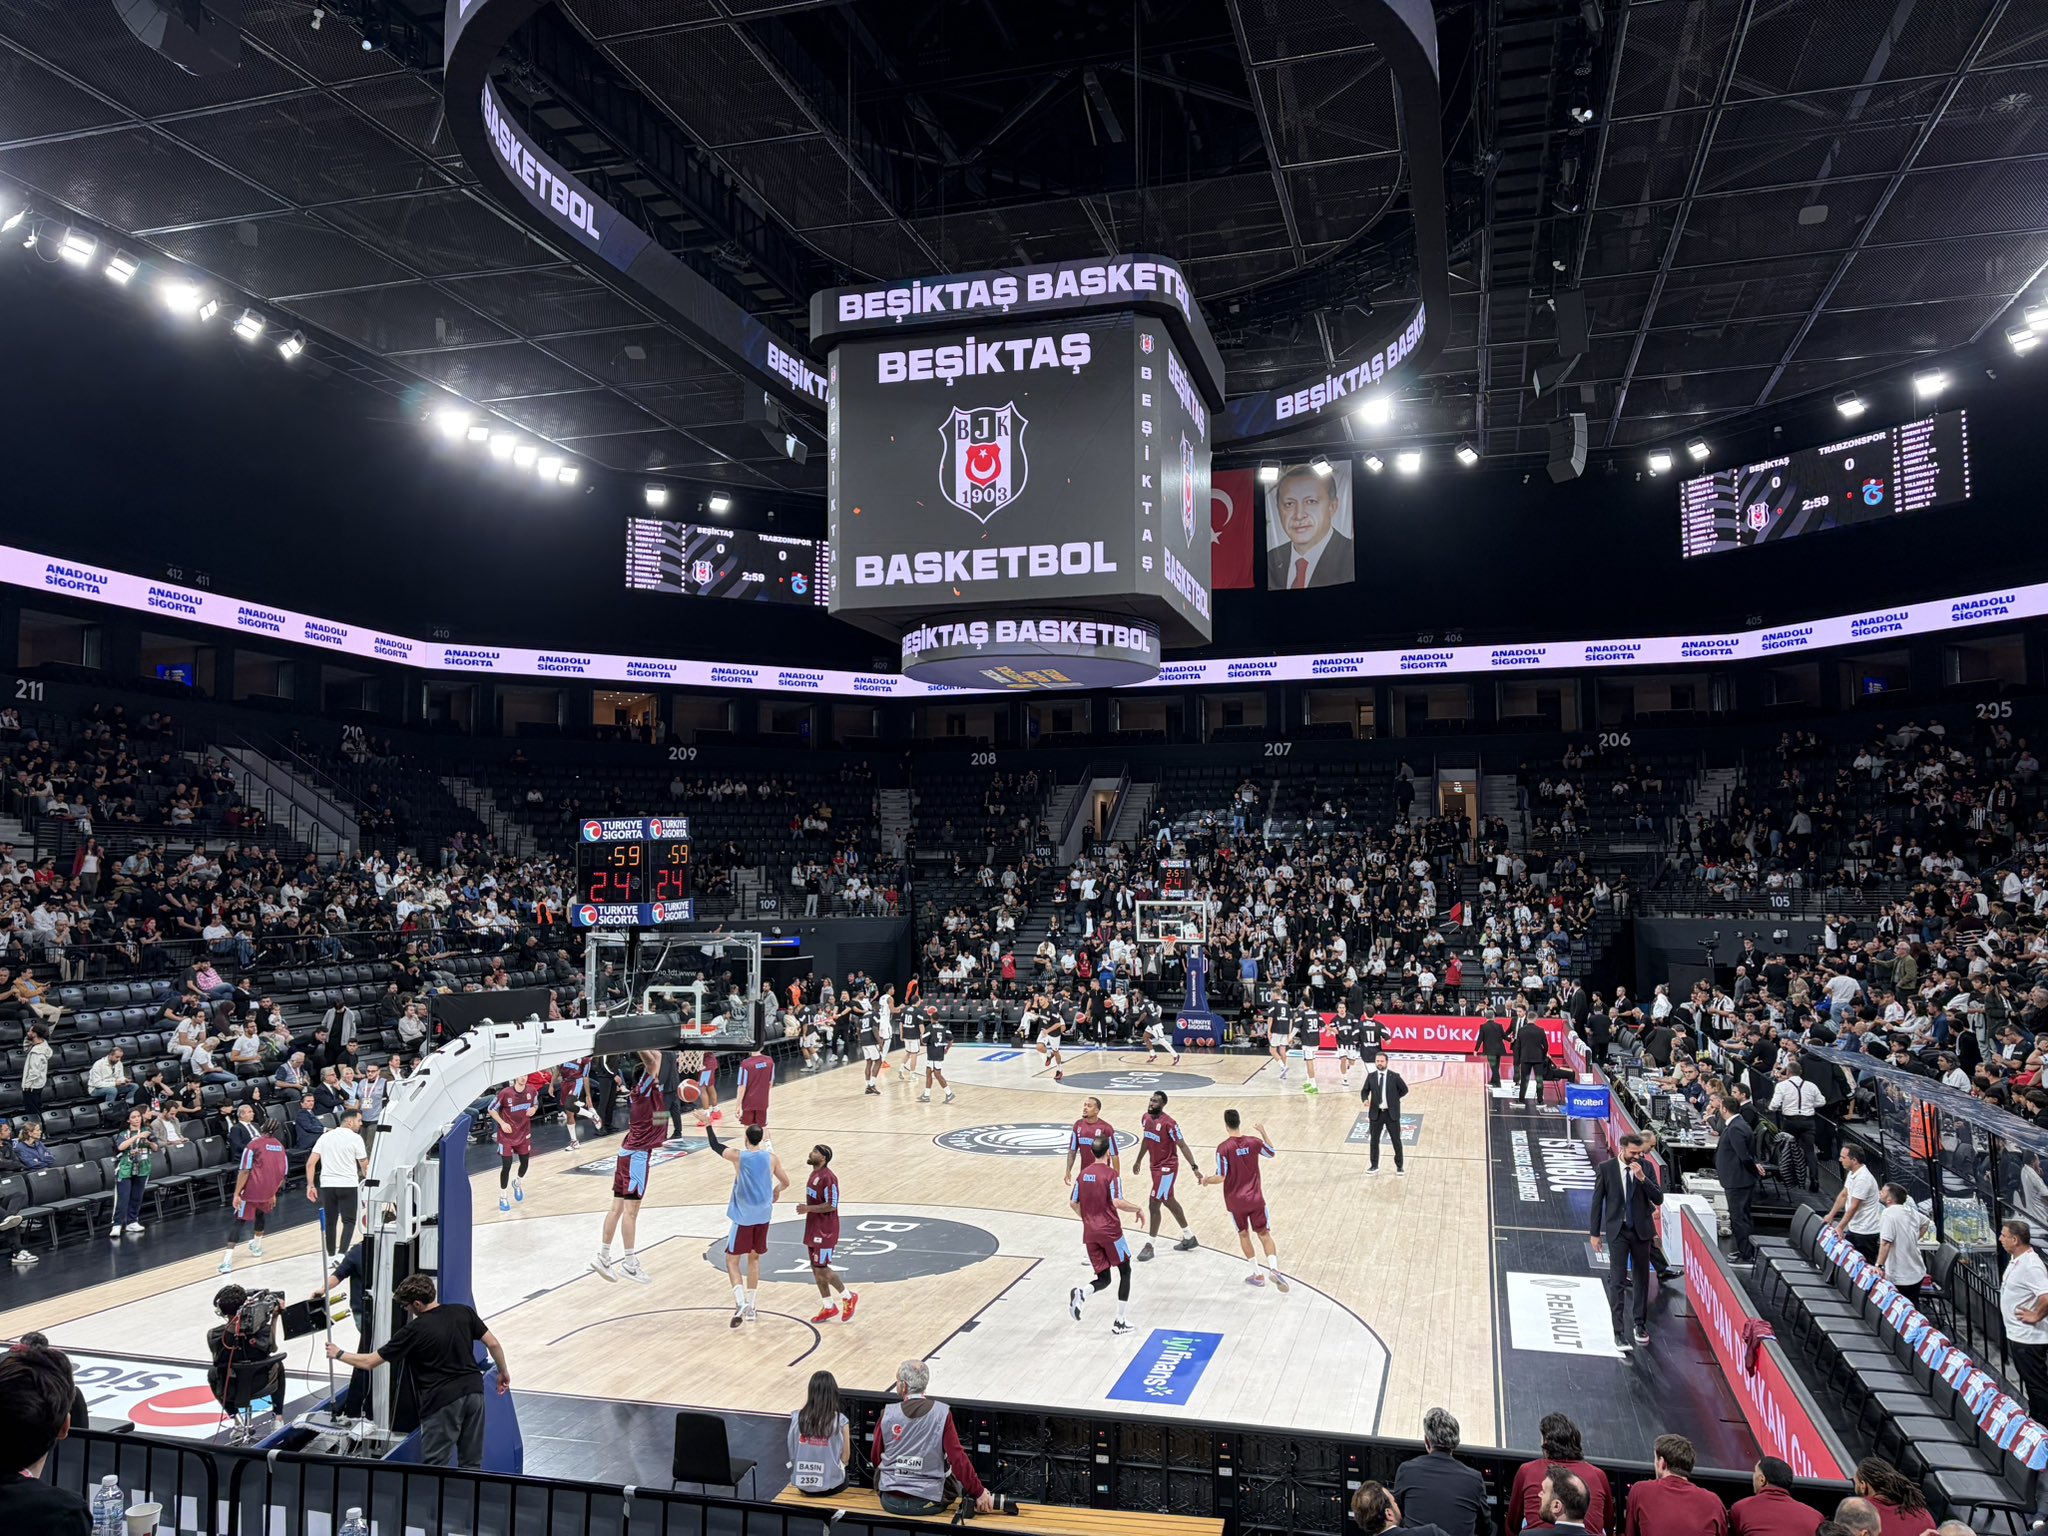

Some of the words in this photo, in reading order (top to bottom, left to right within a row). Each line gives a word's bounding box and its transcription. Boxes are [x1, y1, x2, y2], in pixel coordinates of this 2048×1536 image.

[481, 81, 600, 240] BASKETBOL
[839, 276, 1018, 323] BEŞİKTAŞ
[1027, 263, 1191, 323] BASKETBOL
[878, 333, 1091, 386] BEŞİKTAŞ
[1276, 352, 1384, 420] BEŞİKTAŞ
[1168, 349, 1205, 443] BEŞİKTAŞ
[956, 415, 1010, 440] BJK
[1818, 432, 1887, 455] TRABZONSPOR
[1749, 457, 1790, 473] BEŞİKTAŞ
[1844, 458, 1855, 470] 0
[1771, 477, 1781, 488] 0
[962, 486, 1008, 504] 1903
[1802, 495, 1829, 510] 2:59
[697, 527, 734, 538] BEŞİKTAŞ
[758, 534, 812, 546] TRABZONSPOR
[717, 544, 725, 554] 0
[779, 551, 787, 561] 0
[856, 541, 1117, 587] BASKETBOL
[46, 563, 108, 585] ANADOLU
[166, 567, 183, 580] 412
[196, 573, 210, 587] 411
[742, 571, 765, 582] 2:59
[45, 573, 100, 595] SİGORTA
[1164, 547, 1210, 621] BASKETBOL
[148, 586, 203, 606] ANADOLU
[147, 595, 196, 615] SİGORTA
[1951, 594, 2016, 613] ANADOLU
[238, 606, 286, 624] ANADOLU
[1951, 605, 2009, 622] SİGORTA
[237, 615, 281, 632] SİGORTA
[1746, 616, 1763, 626] 405
[1851, 611, 1909, 629] ANADOLU
[304, 621, 348, 637] ANADOLU
[433, 629, 450, 639] 410
[1761, 627, 1813, 642] ANADOLU
[1851, 621, 1903, 637] SİGORTA
[304, 629, 342, 645] SİGORTA
[902, 623, 989, 657] BEŞİKTAŞ
[996, 620, 1150, 653] BASKETBOL
[1417, 634, 1434, 644] 407
[1444, 633, 1463, 643] 406
[374, 636, 412, 651] ANADOLU
[1585, 643, 1642, 654] ANADOLU
[1681, 638, 1739, 649] ANADOLU
[1761, 636, 1808, 651] SİGORTA
[374, 645, 408, 659] SİGORTA
[444, 649, 500, 660] ANADOLU
[1400, 652, 1454, 662] ANADOLU
[1491, 647, 1546, 658] ANADOLU
[1585, 651, 1635, 662] SİGORTA
[1681, 647, 1733, 657] SİGORTA
[444, 656, 493, 668] SİGORTA
[537, 655, 591, 666] ANADOLU
[627, 661, 677, 671] ANADOLU
[1227, 661, 1277, 671] ANADOLU
[1312, 657, 1364, 667] ANADOLU
[1400, 660, 1448, 670] SİGORTA
[1491, 656, 1540, 666] SİGORTA
[537, 662, 584, 673] SİGORTA
[626, 667, 671, 679] SİGORTA
[711, 667, 758, 677] ANADOLU
[1159, 664, 1207, 674] ANADOLU
[1227, 669, 1272, 678] SİGORTA
[1312, 665, 1358, 674] SİGORTA
[711, 673, 753, 683] SİGORTA
[778, 671, 823, 682] ANADOLU
[854, 677, 898, 685] ANADOLU
[1159, 672, 1201, 682] SİGORTA
[778, 678, 818, 688] SİGORTA
[854, 683, 892, 692] SİGORTA
[15, 679, 44, 701] 211
[1975, 701, 2013, 719] 205
[342, 725, 363, 741] 210
[1598, 732, 1632, 748] 206
[668, 747, 698, 761] 209
[1264, 742, 1293, 757] 207
[971, 752, 997, 766] 208
[1092, 846, 1104, 855] 10
[590, 872, 631, 902] 24
[657, 870, 683, 900] 24
[1165, 879, 1182, 890] 24
[760, 899, 776, 909] 109
[1769, 895, 1791, 908] 105
[904, 1014, 913, 1024] 10
[1307, 1018, 1318, 1030] 30
[1366, 1030, 1375, 1042] 11
[1573, 1098, 1604, 1107] molten
[1684, 1239, 1733, 1360] PASSO'DAN
[1545, 1293, 1583, 1349] RENAULT
[799, 1463, 822, 1471] BASIN
[800, 1476, 819, 1484] 2357
